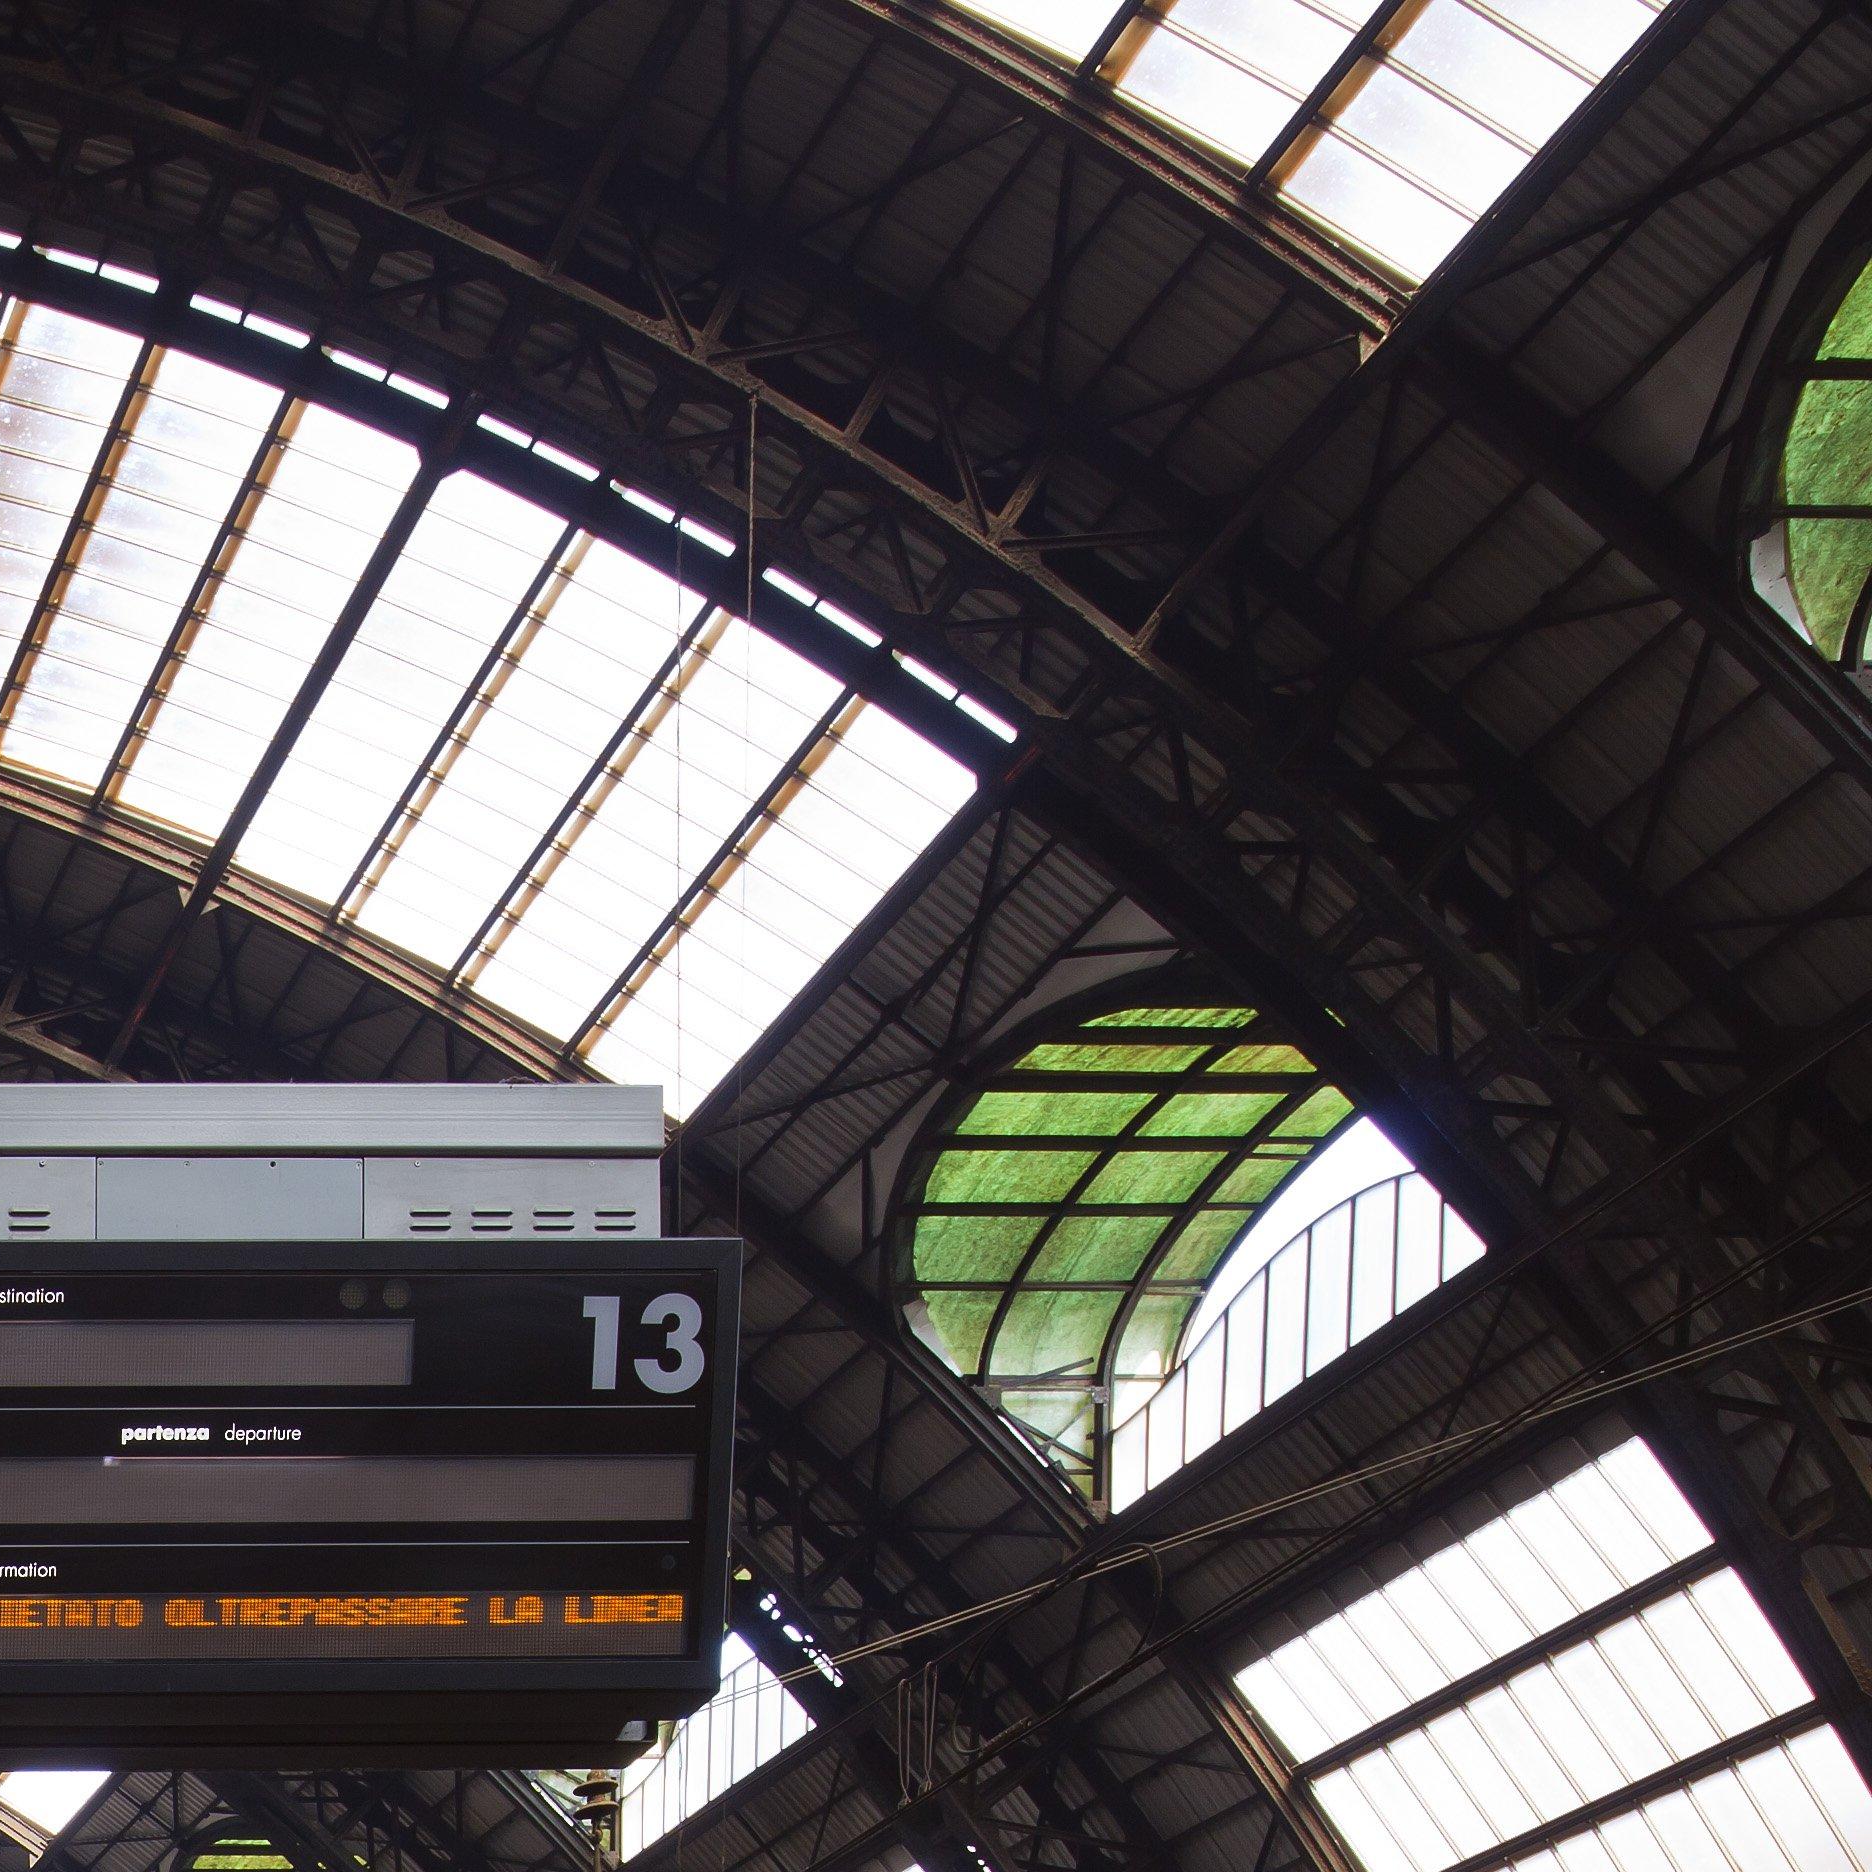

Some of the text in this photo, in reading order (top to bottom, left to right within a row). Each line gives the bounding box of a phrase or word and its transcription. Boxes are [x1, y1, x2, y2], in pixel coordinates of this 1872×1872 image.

[582, 1292, 705, 1394] 13
[121, 1422, 302, 1446] partenza departure
[488, 1595, 544, 1626] LA
[564, 1593, 684, 1625] LINEA
